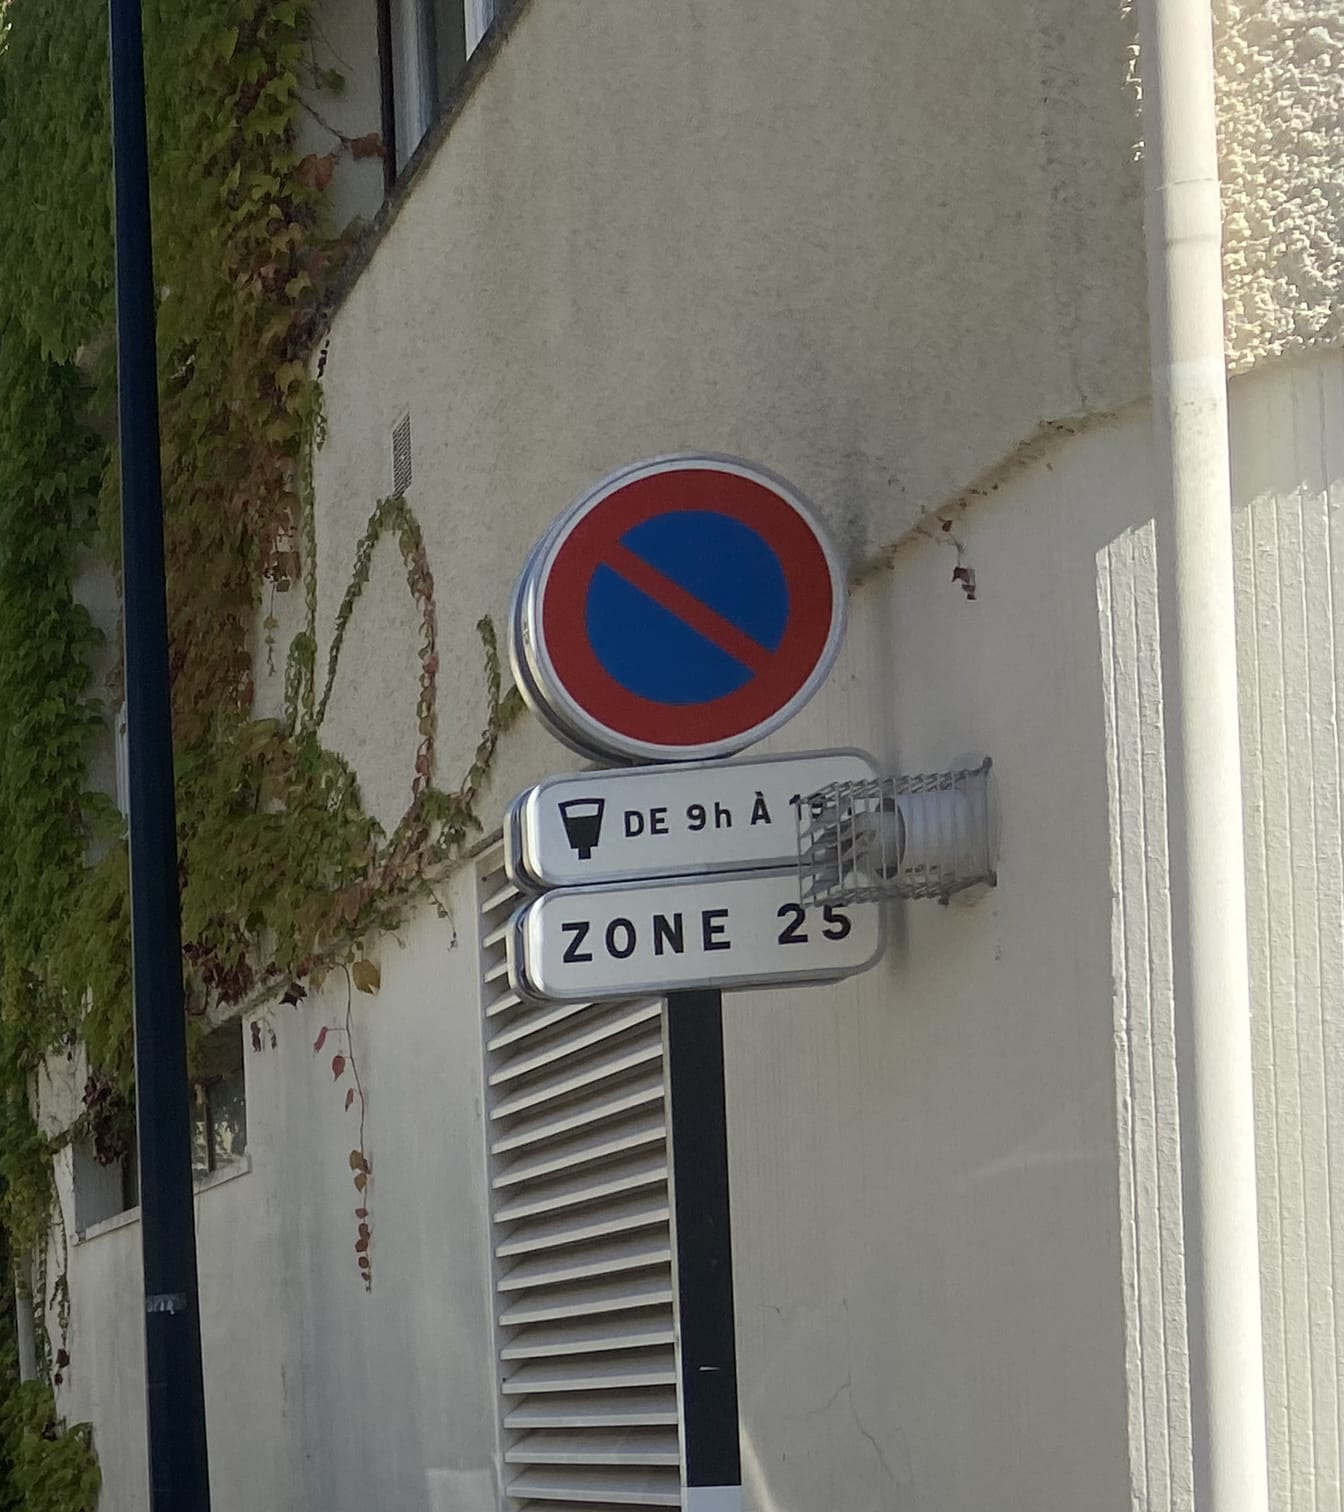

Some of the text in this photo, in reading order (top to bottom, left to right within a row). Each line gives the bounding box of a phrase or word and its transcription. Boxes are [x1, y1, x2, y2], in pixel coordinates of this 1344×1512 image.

[623, 806, 670, 838] DE
[685, 801, 733, 832] 9h
[749, 790, 773, 826] À
[560, 902, 853, 964] ZONE 25
